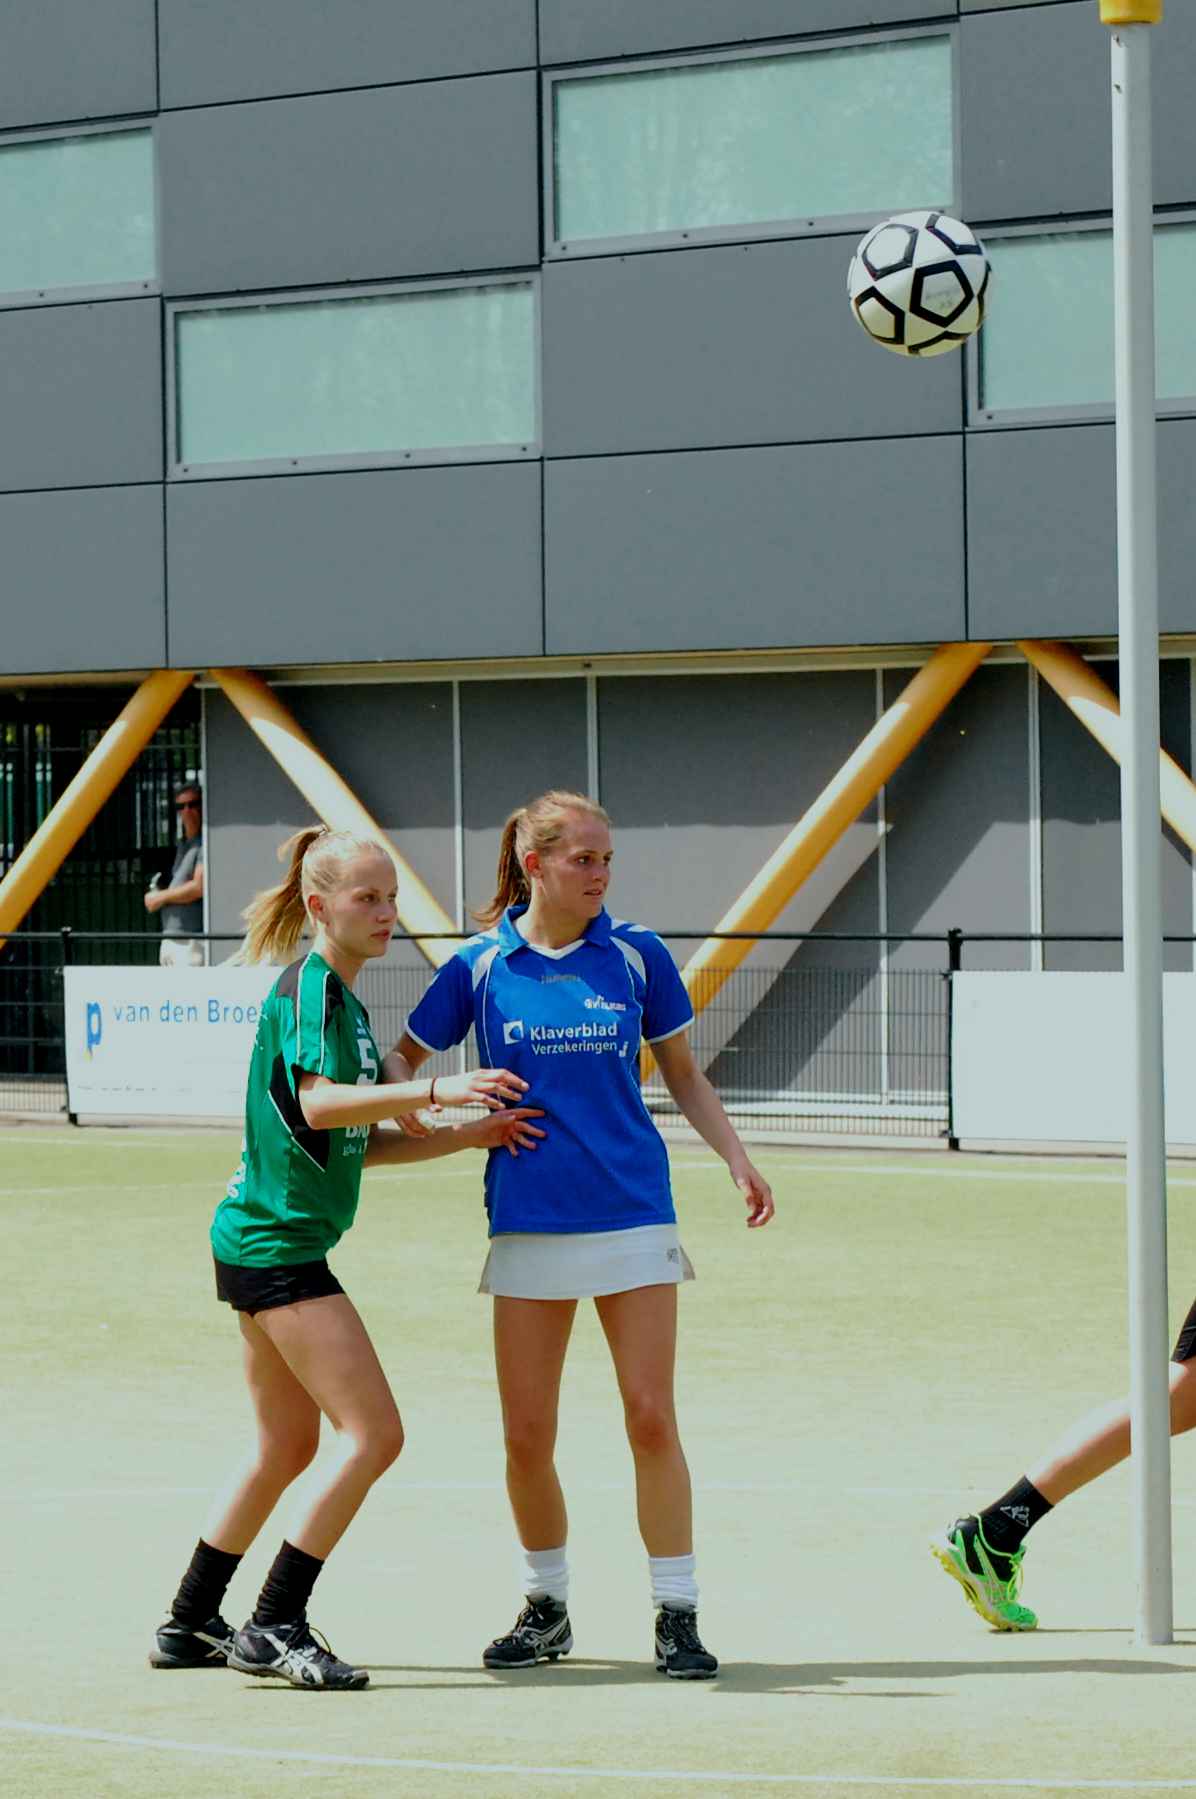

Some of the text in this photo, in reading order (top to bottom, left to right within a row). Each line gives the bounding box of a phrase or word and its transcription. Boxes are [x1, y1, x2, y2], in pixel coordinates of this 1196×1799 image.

[113, 999, 262, 1024] van den Broe
[530, 1021, 618, 1041] Klaverblad
[531, 1040, 618, 1056] Verzekeringen
[356, 1038, 378, 1085] 5
